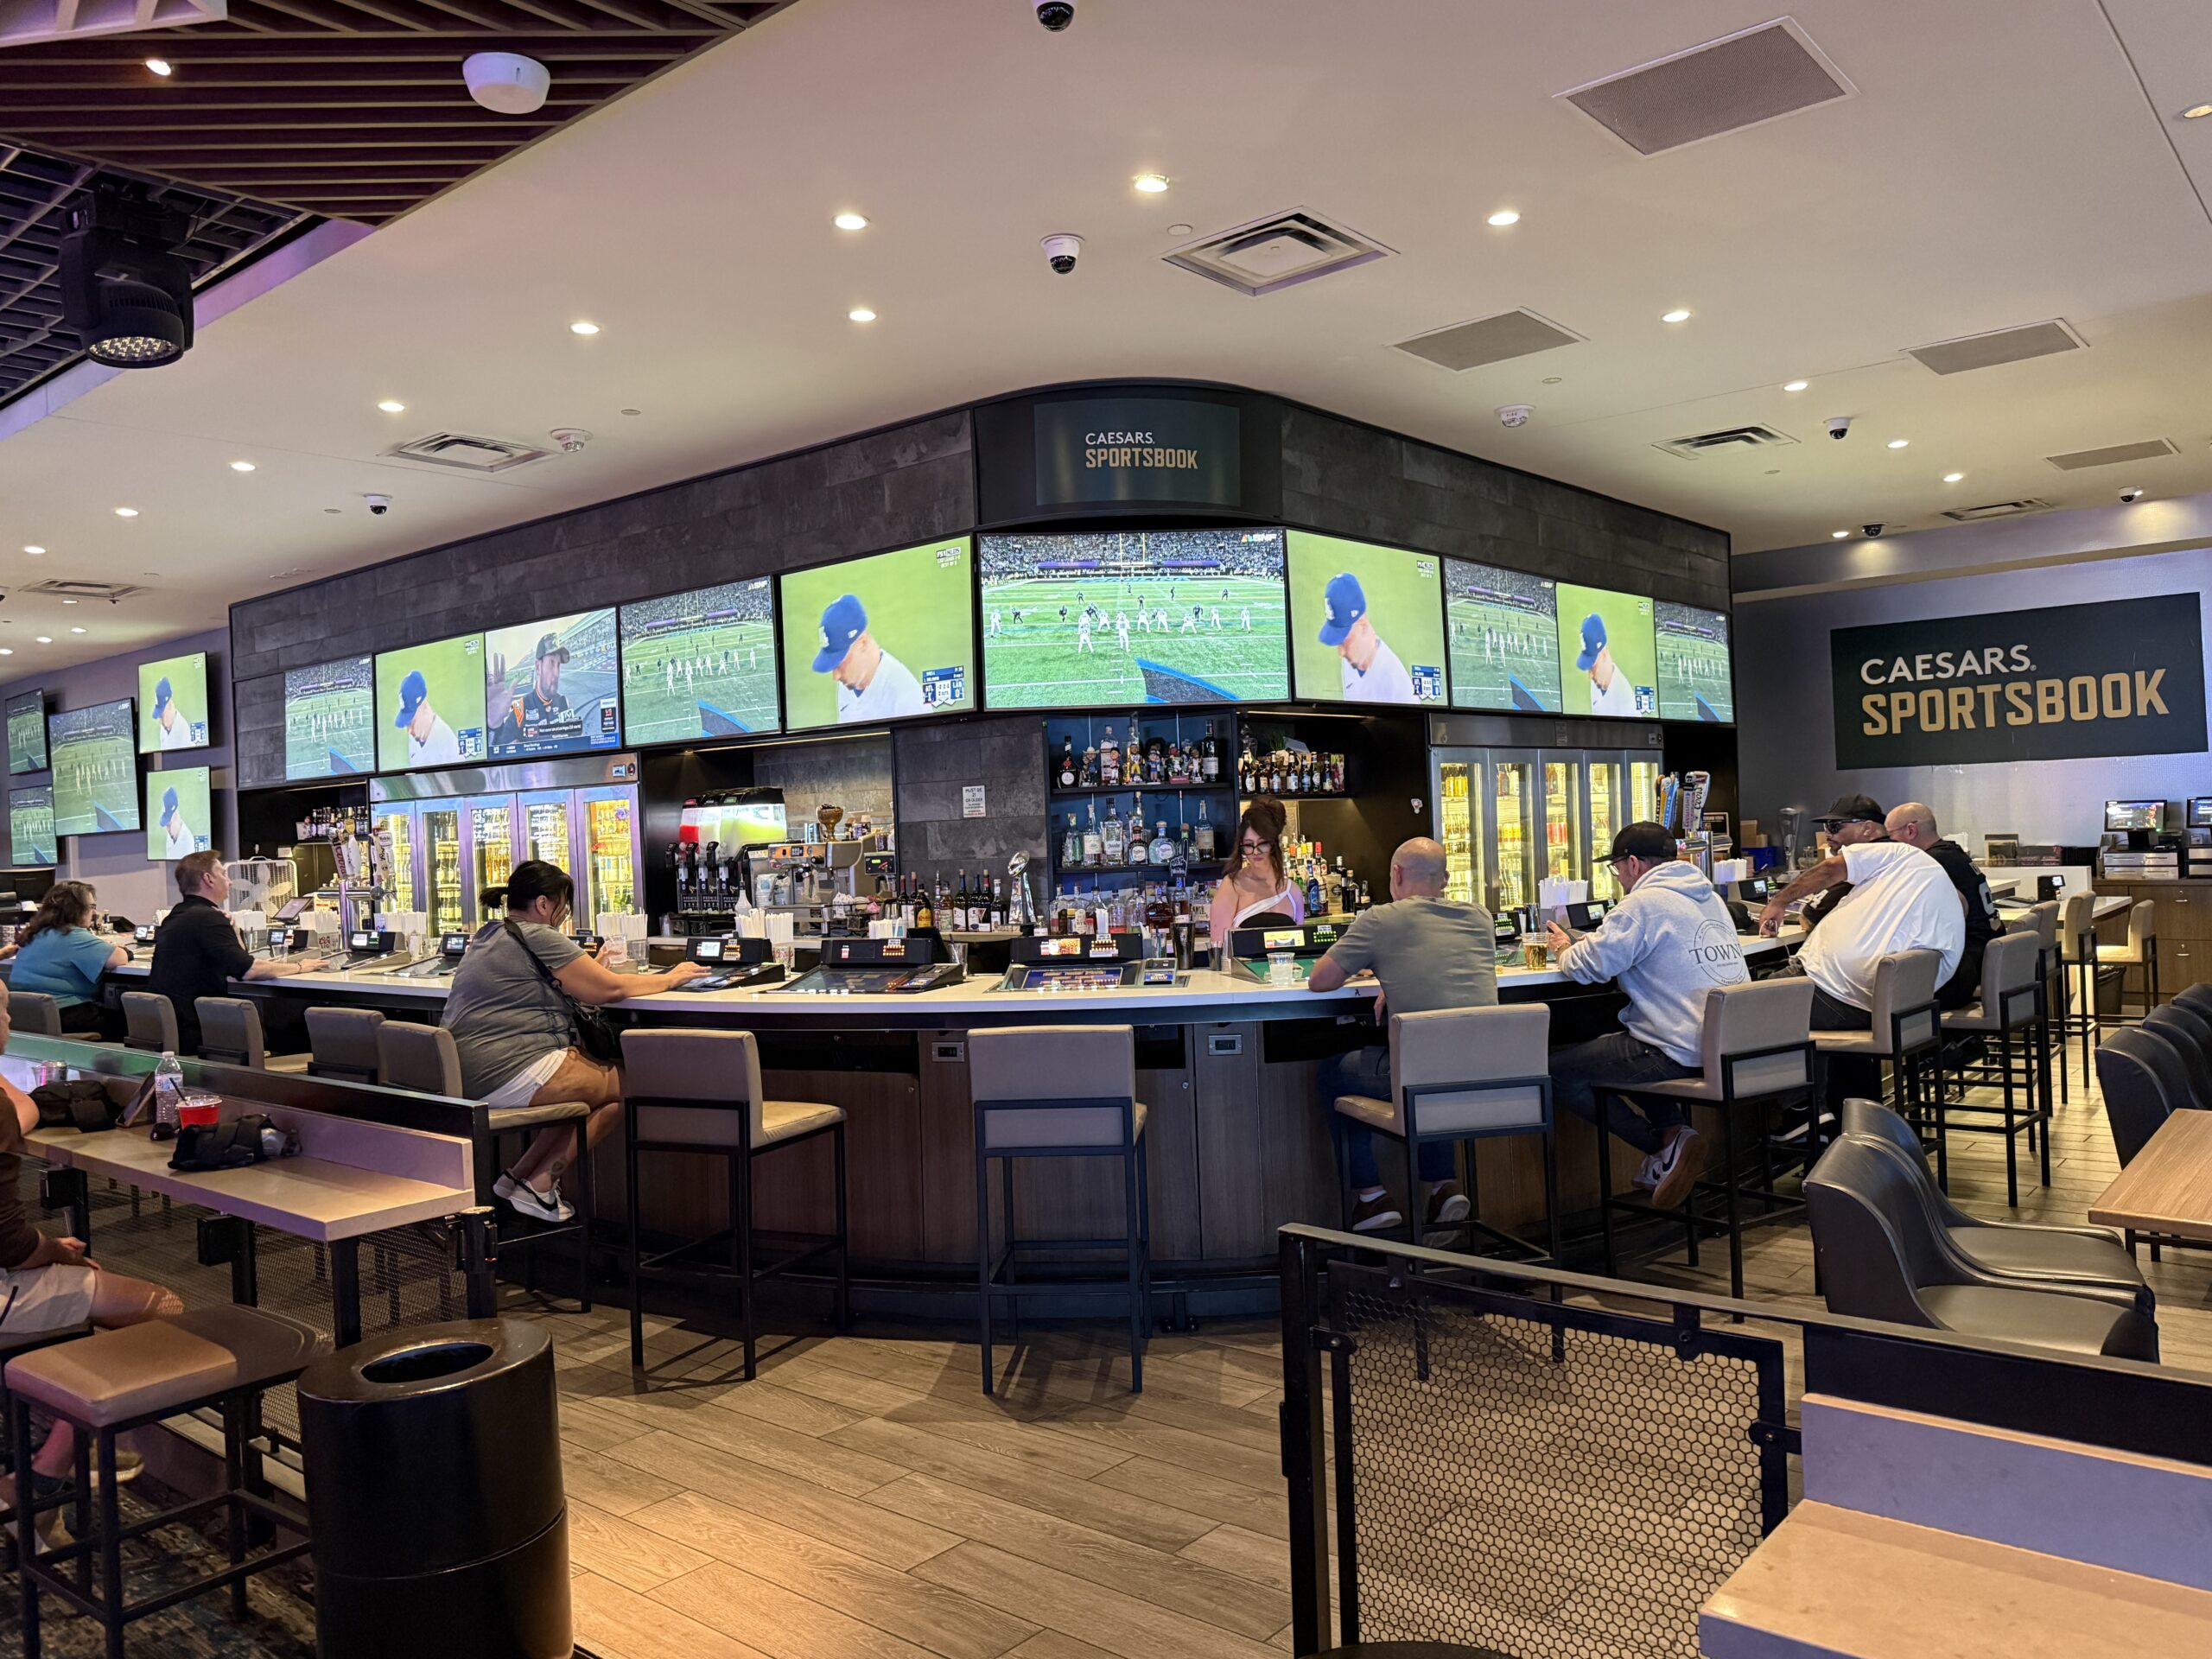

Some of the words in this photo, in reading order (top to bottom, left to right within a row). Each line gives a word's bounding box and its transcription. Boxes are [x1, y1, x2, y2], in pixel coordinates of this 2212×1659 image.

[1084, 431, 1154, 445] CAESARS
[1084, 447, 1198, 470] SPORTSBOOK
[1859, 643, 2032, 685] CAESARS
[1861, 668, 2171, 737] SPORTSBOOK
